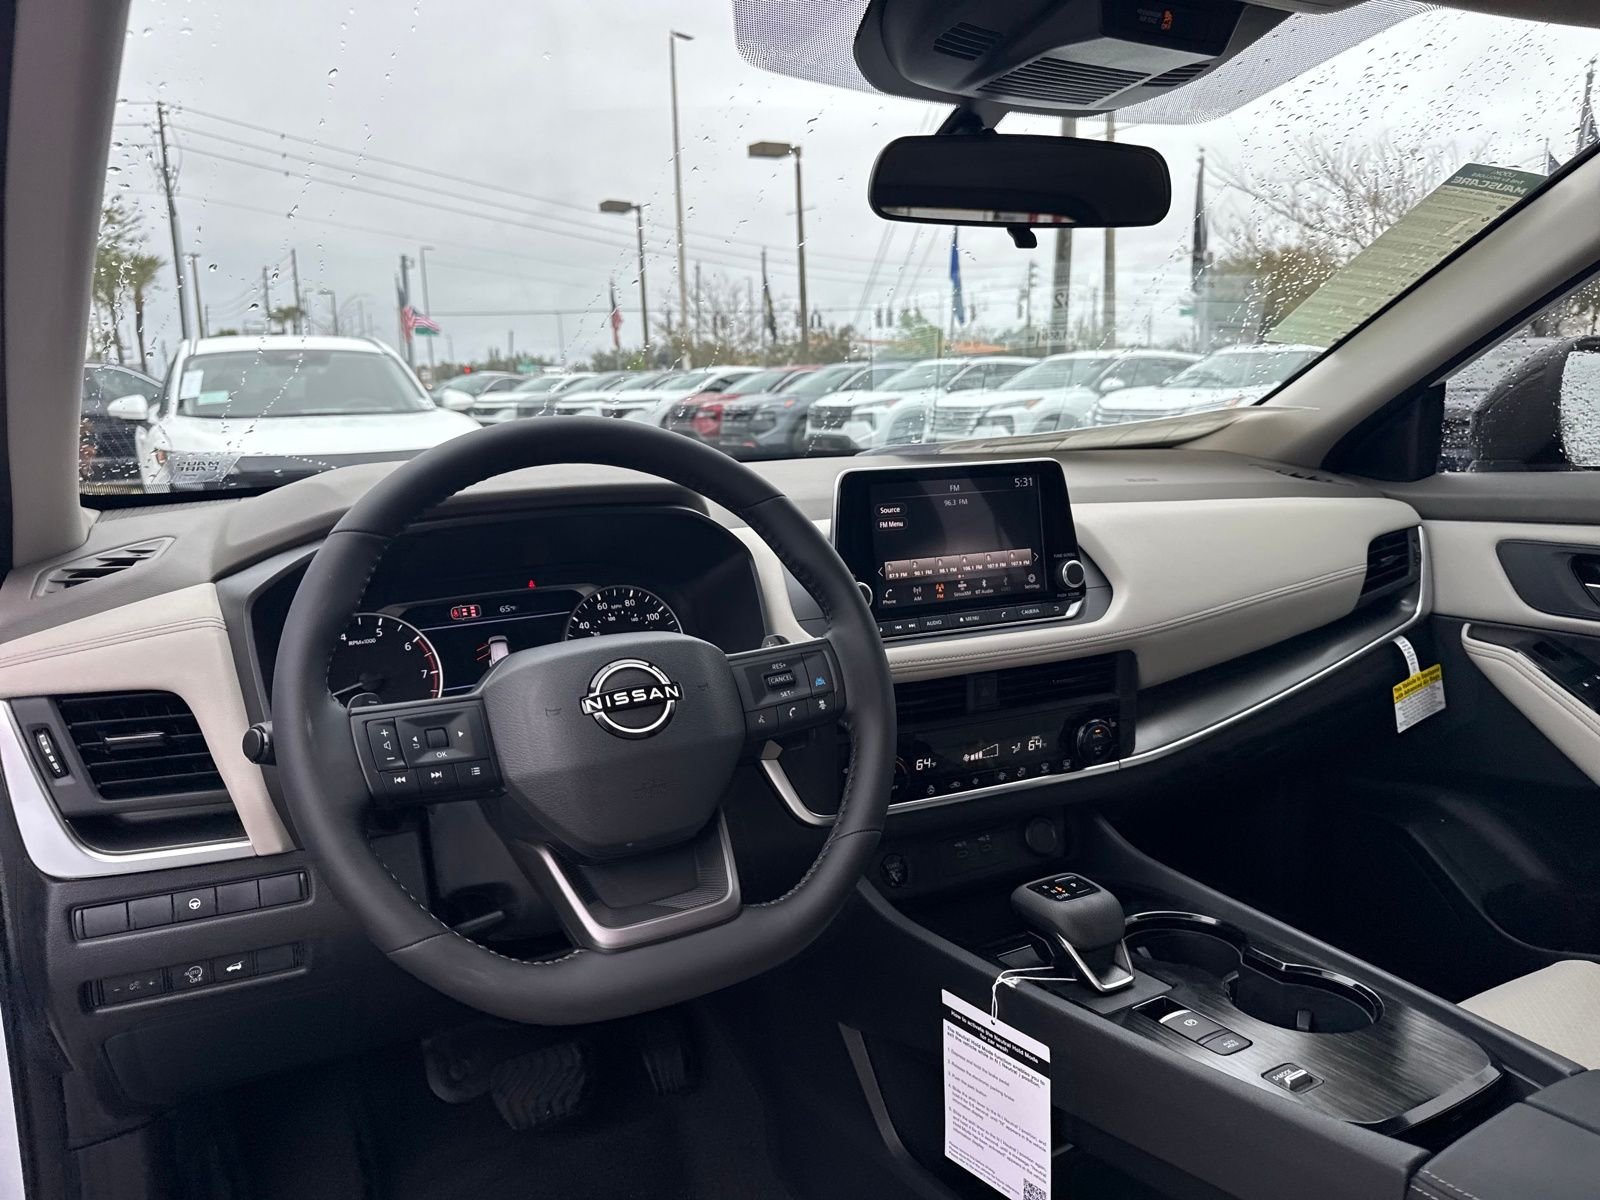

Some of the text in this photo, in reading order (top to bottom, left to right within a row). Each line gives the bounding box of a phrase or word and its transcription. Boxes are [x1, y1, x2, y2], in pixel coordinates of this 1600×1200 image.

[1014, 477, 1033, 488] 5:31
[889, 520, 904, 528] Menu
[376, 628, 383, 637] 5
[404, 642, 412, 651] 6
[421, 669, 427, 679] 7
[770, 674, 793, 684] CANCEL
[584, 686, 680, 712] NISSAN
[993, 1034, 1010, 1048] Neutral
[1011, 1044, 1023, 1056] Hold
[1024, 1051, 1038, 1064] Mode
